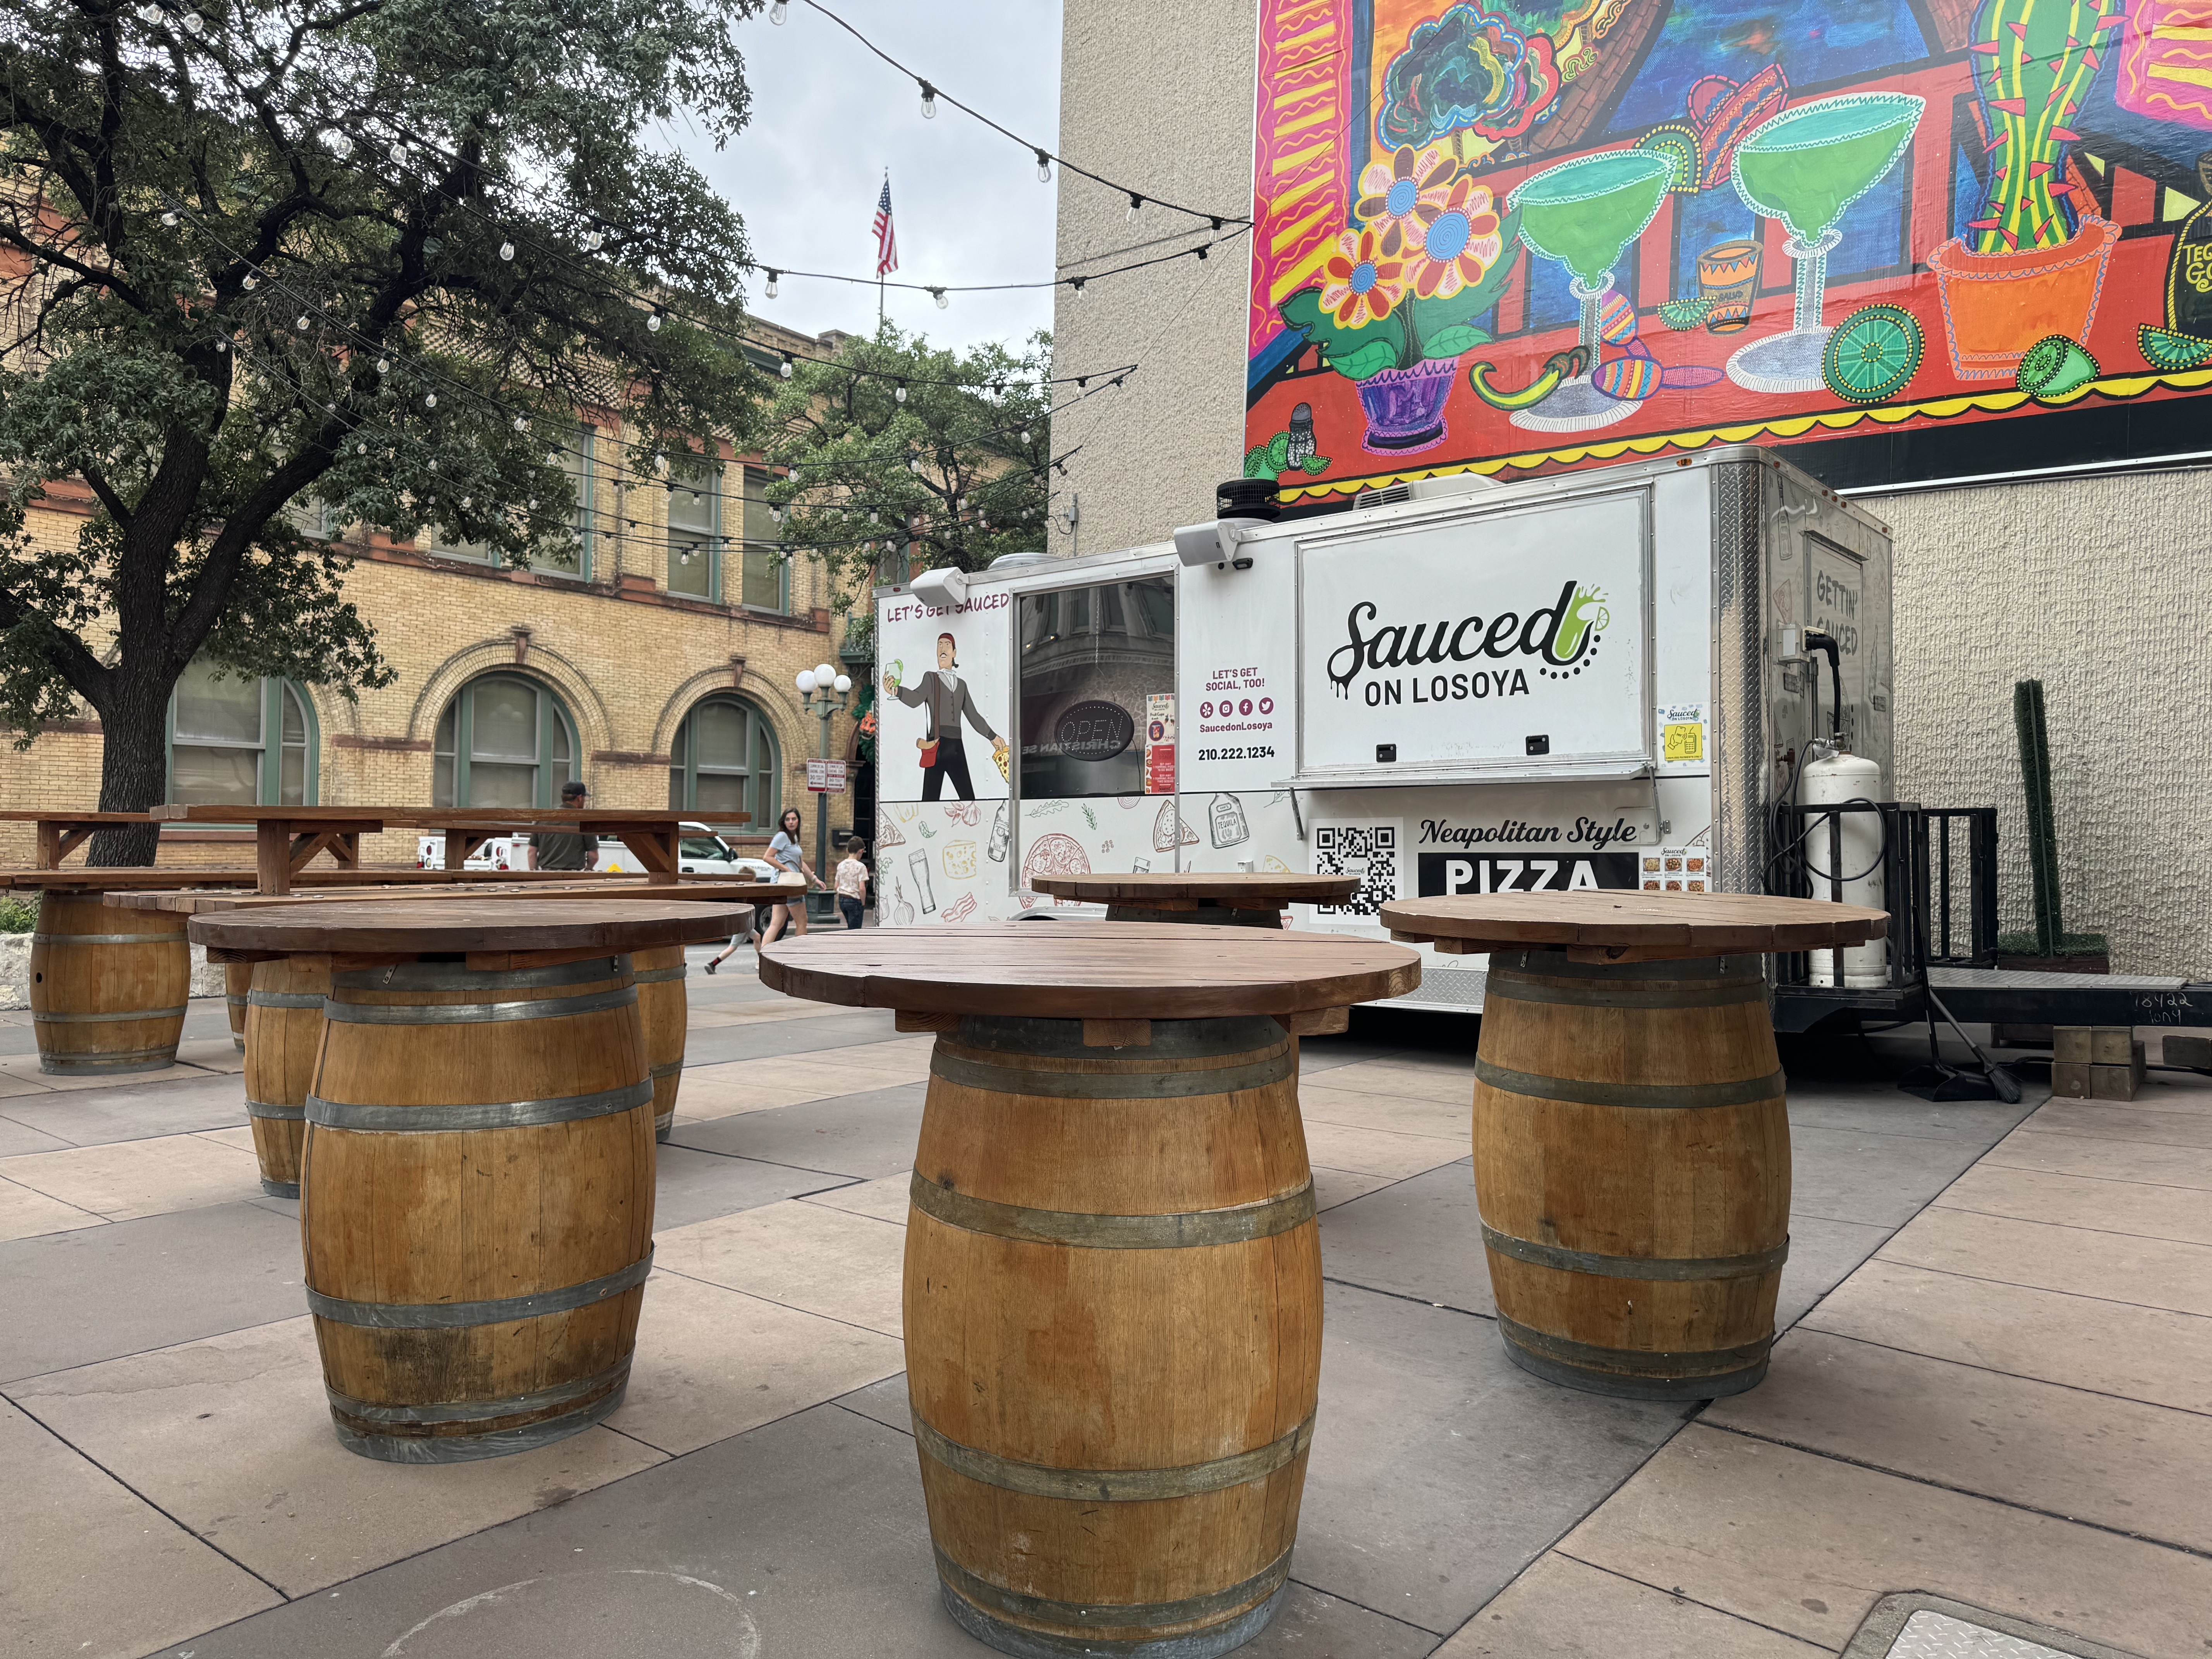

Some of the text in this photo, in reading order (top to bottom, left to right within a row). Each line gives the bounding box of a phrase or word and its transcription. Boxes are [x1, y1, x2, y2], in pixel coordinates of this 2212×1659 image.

[1817, 570, 1858, 620] GETTIN'
[888, 604, 923, 623] LET'S
[1327, 580, 1594, 700] Sauced
[1817, 617, 1858, 656] UCED
[1213, 667, 1257, 679] LET'S GET
[1206, 678, 1264, 691] SOCIAL, TOO!
[1365, 668, 1530, 706] ON LOSOYA
[1667, 708, 1699, 719] Sauced
[1061, 715, 1123, 742] OPEN
[1200, 722, 1273, 732] SaucedonLosoya
[1199, 746, 1274, 760] 210.222.1234
[1218, 818, 1237, 830] TEQUILA
[1419, 816, 1637, 850] Neapolitan Style
[1661, 847, 1687, 855] Sauced
[1446, 860, 1599, 896] PIZZA
